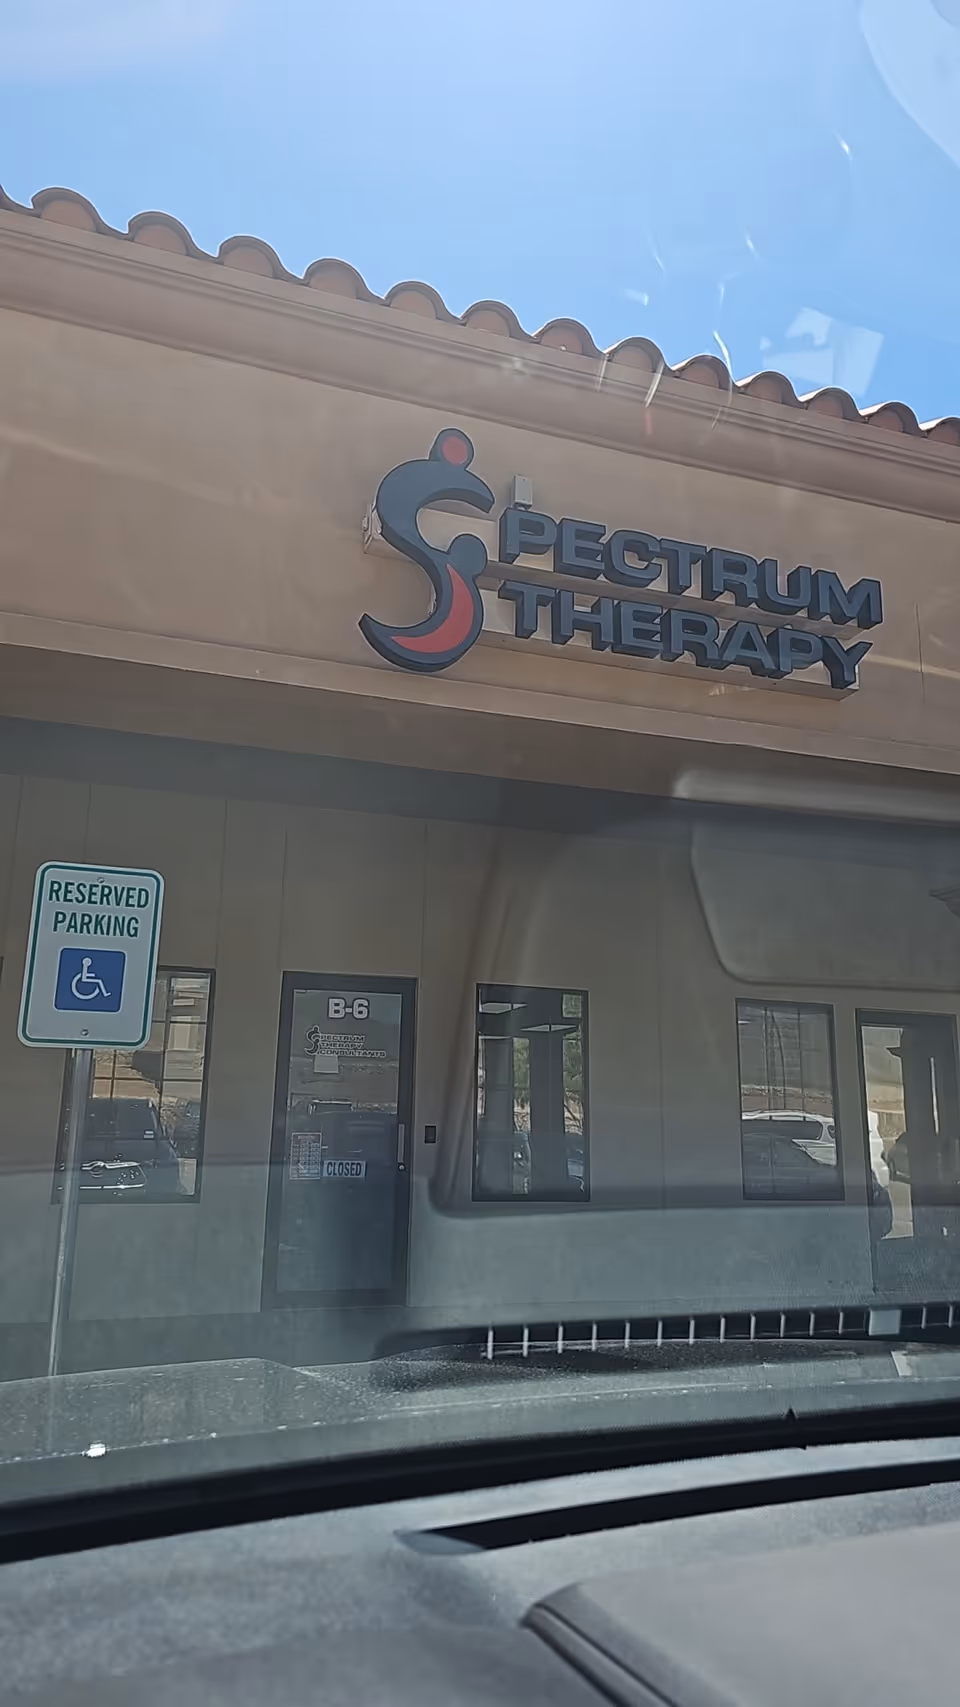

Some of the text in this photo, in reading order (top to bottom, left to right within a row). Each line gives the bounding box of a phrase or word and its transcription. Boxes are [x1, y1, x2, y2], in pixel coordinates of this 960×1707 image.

[498, 580, 873, 689] THERAPY
[48, 880, 150, 909] RESERVED
[53, 911, 140, 938] PARKING
[328, 997, 369, 1019] B-6
[319, 1049, 386, 1058] CONSULTANTS
[320, 1041, 364, 1050] THERAPY
[326, 1161, 362, 1177] CLOSED
